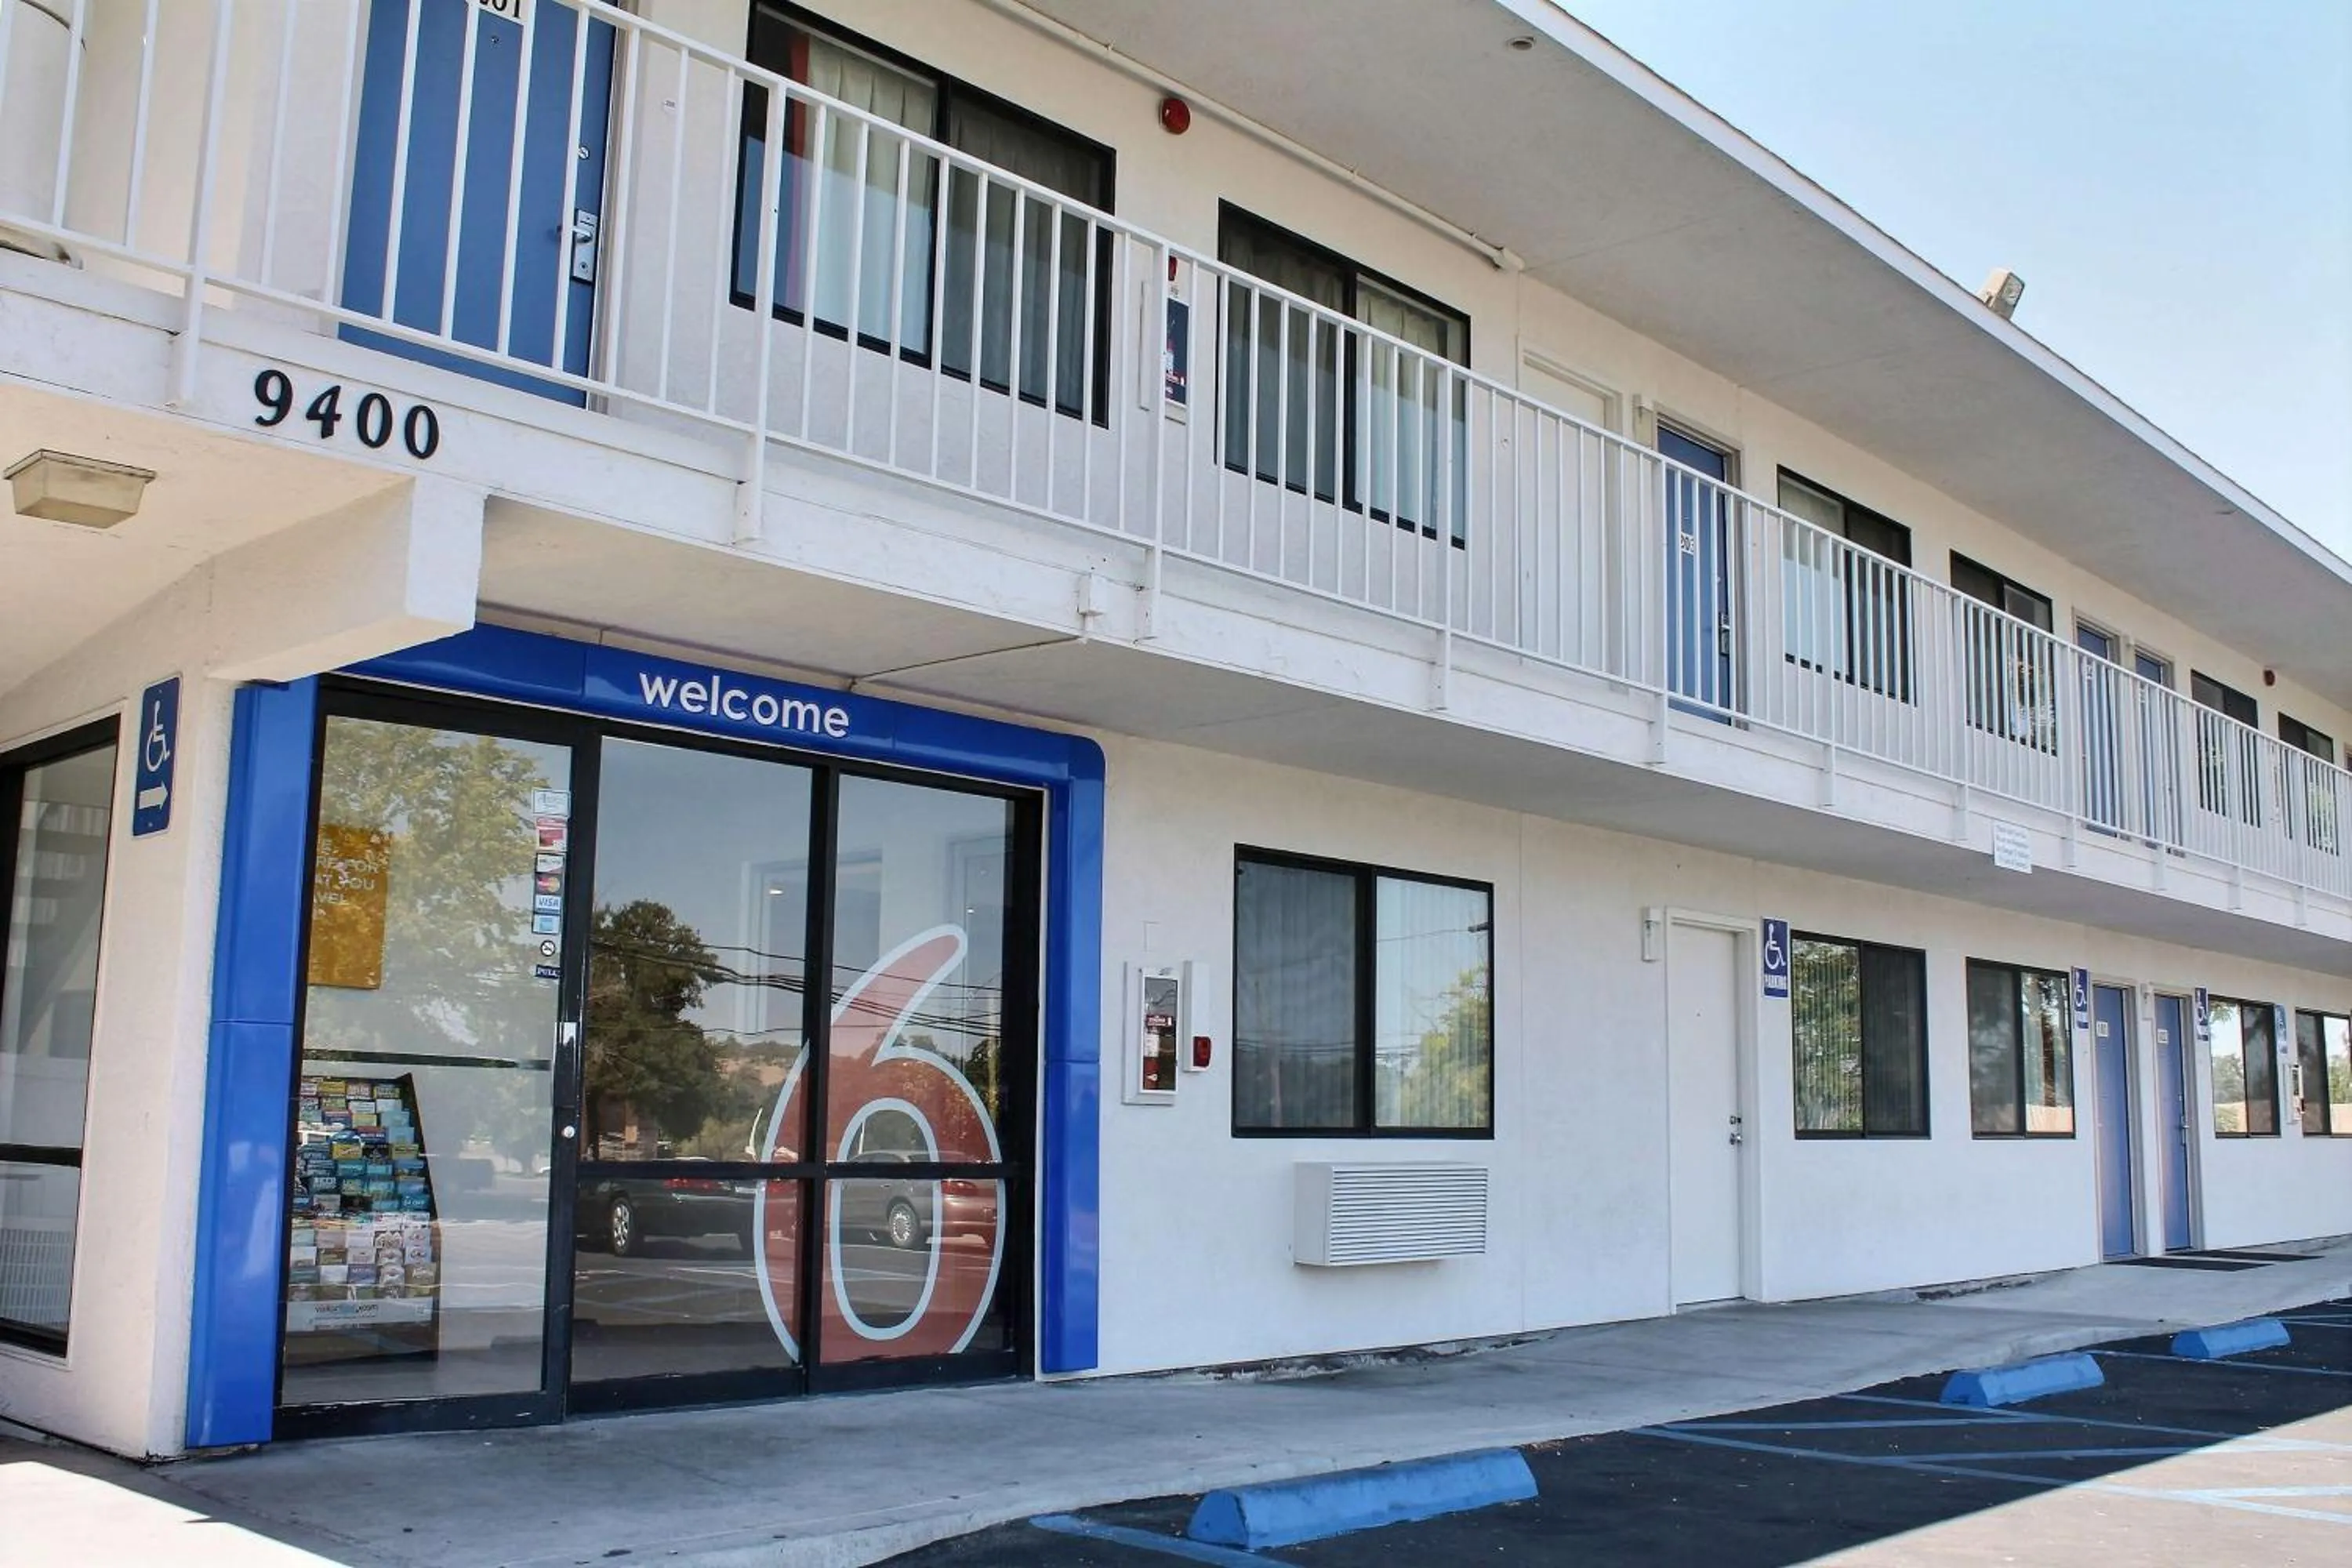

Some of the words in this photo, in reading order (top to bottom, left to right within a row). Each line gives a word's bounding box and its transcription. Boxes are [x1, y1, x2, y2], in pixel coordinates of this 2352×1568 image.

[480, 0, 521, 18] 01
[255, 369, 440, 460] 9400
[639, 673, 850, 738] welcome
[539, 896, 559, 907] VISA
[753, 924, 1006, 1364] 6
